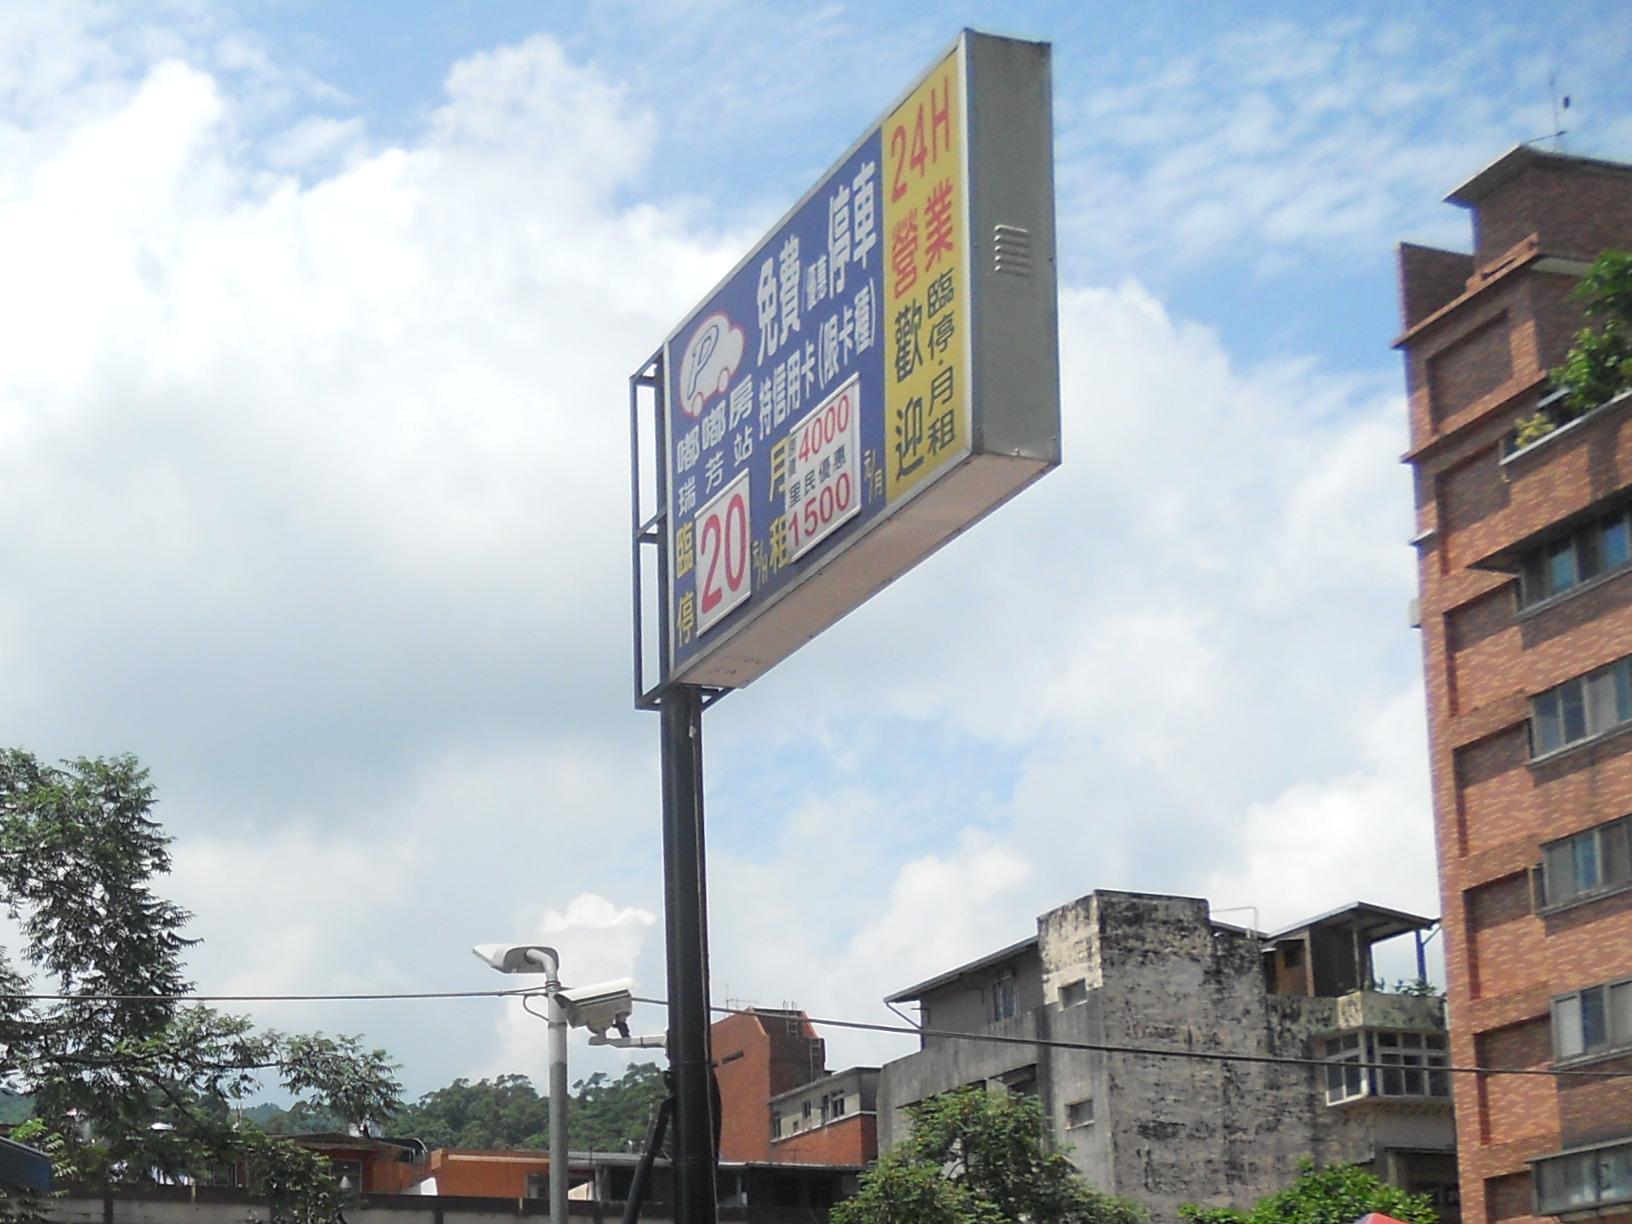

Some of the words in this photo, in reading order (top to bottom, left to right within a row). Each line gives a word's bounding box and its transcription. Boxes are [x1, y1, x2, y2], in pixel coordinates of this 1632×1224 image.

[891, 75, 950, 204] 24H
[892, 176, 954, 299] 營業
[677, 374, 754, 474] 嘟嘟房
[798, 395, 849, 462] 4000
[895, 298, 924, 482] 歡迎
[678, 426, 753, 518] 瑞芳站
[769, 437, 791, 574] 月租
[788, 472, 851, 547] 1500
[789, 444, 846, 508] 里民優惠
[676, 521, 694, 648] 臨停
[701, 493, 747, 614] 20
